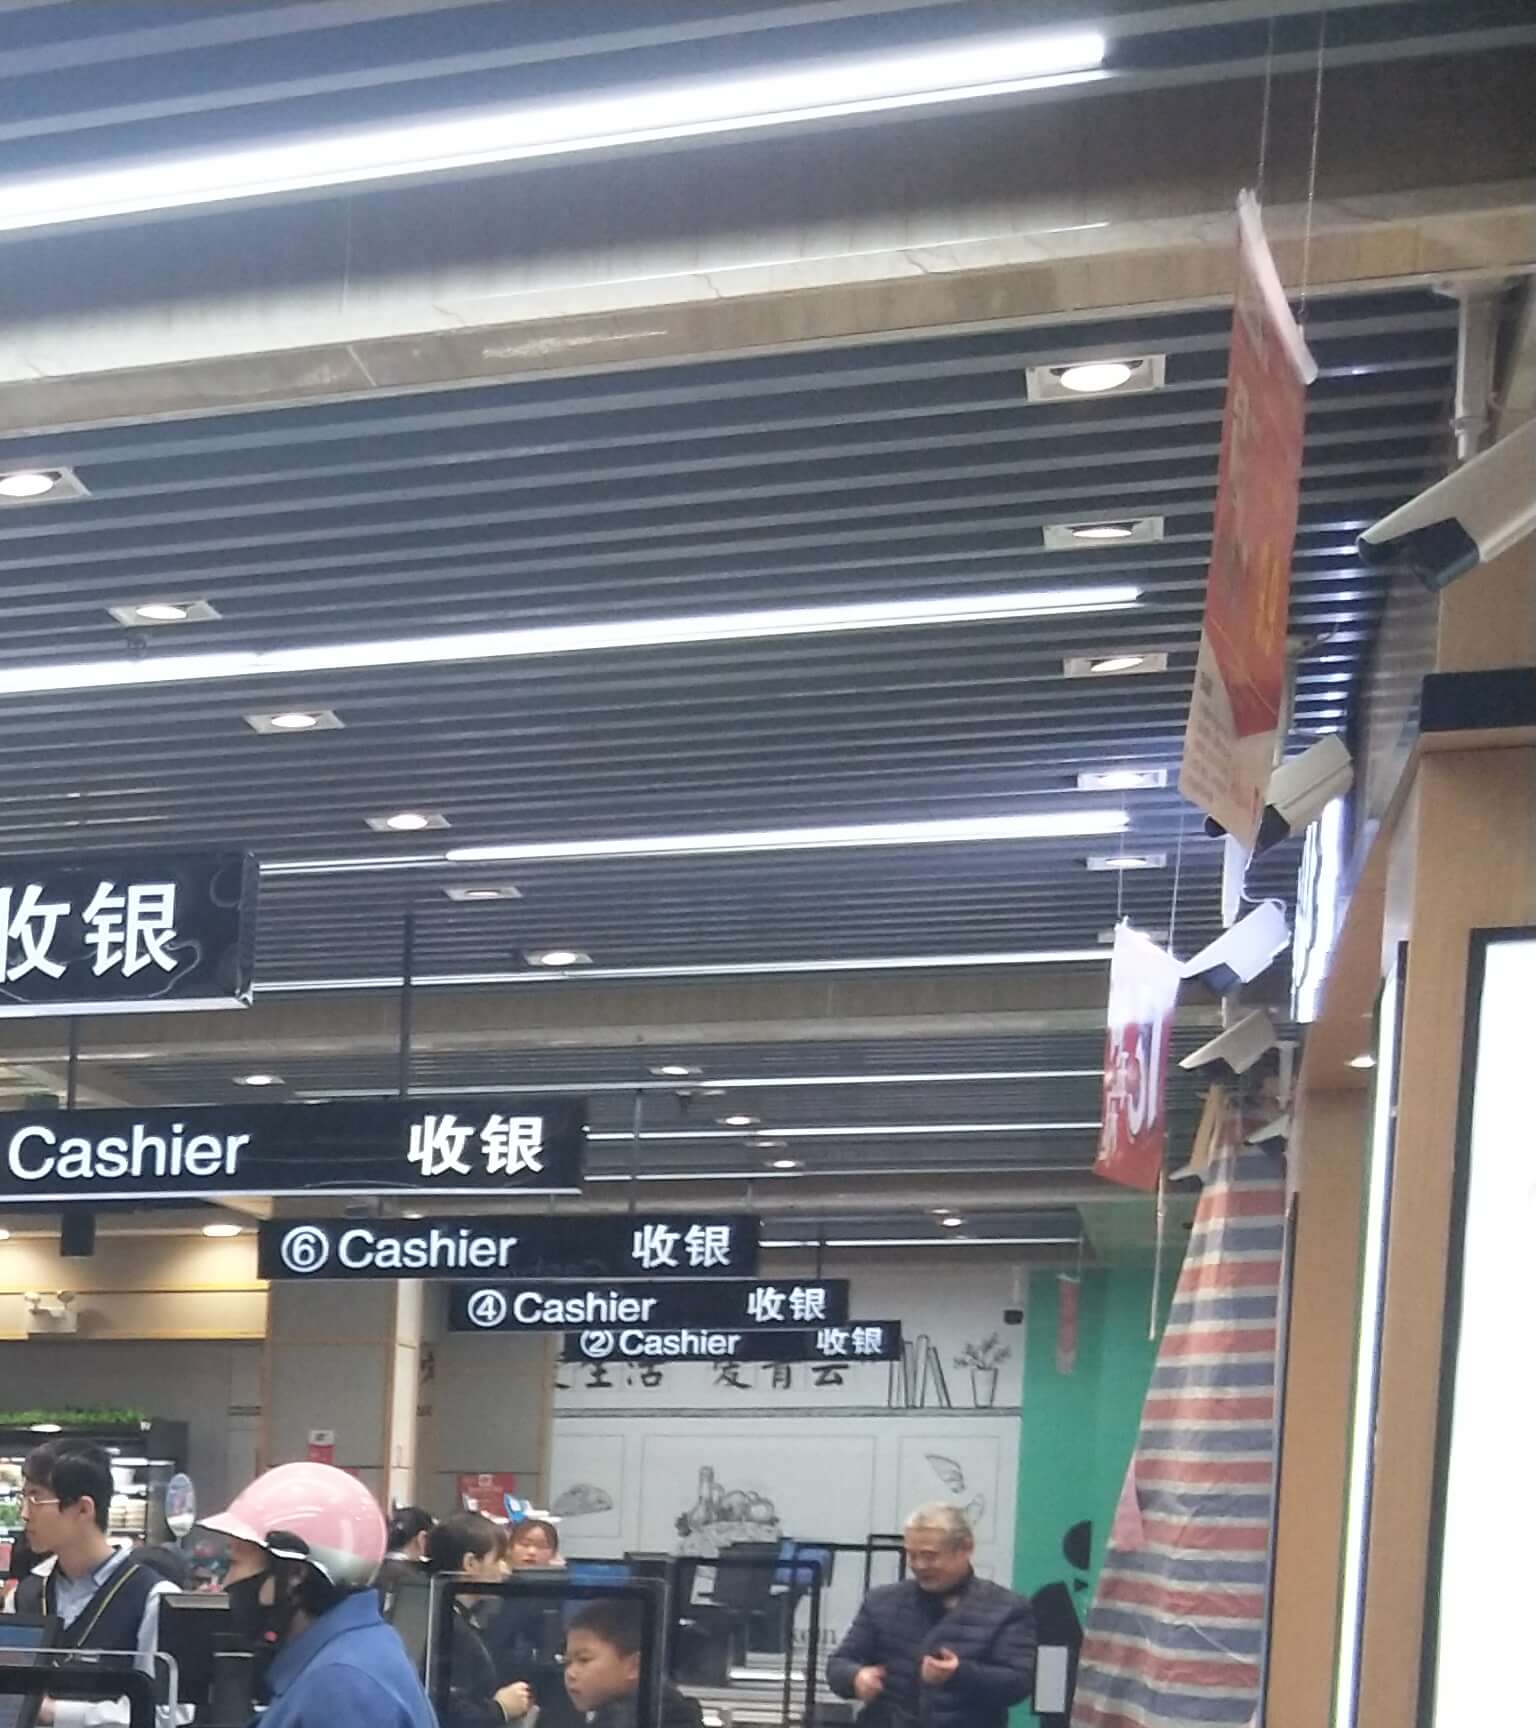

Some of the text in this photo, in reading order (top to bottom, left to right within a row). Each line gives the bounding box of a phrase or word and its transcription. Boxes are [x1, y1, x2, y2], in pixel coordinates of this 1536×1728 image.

[8, 1123, 250, 1180] Cashier
[406, 1114, 545, 1176] 收银
[338, 1229, 517, 1268] Cashier
[631, 1224, 730, 1268] 收银
[513, 1291, 657, 1323] Cashier
[747, 1286, 826, 1322] 收银
[619, 1329, 741, 1356] Cashier
[816, 1326, 883, 1356] 收银
